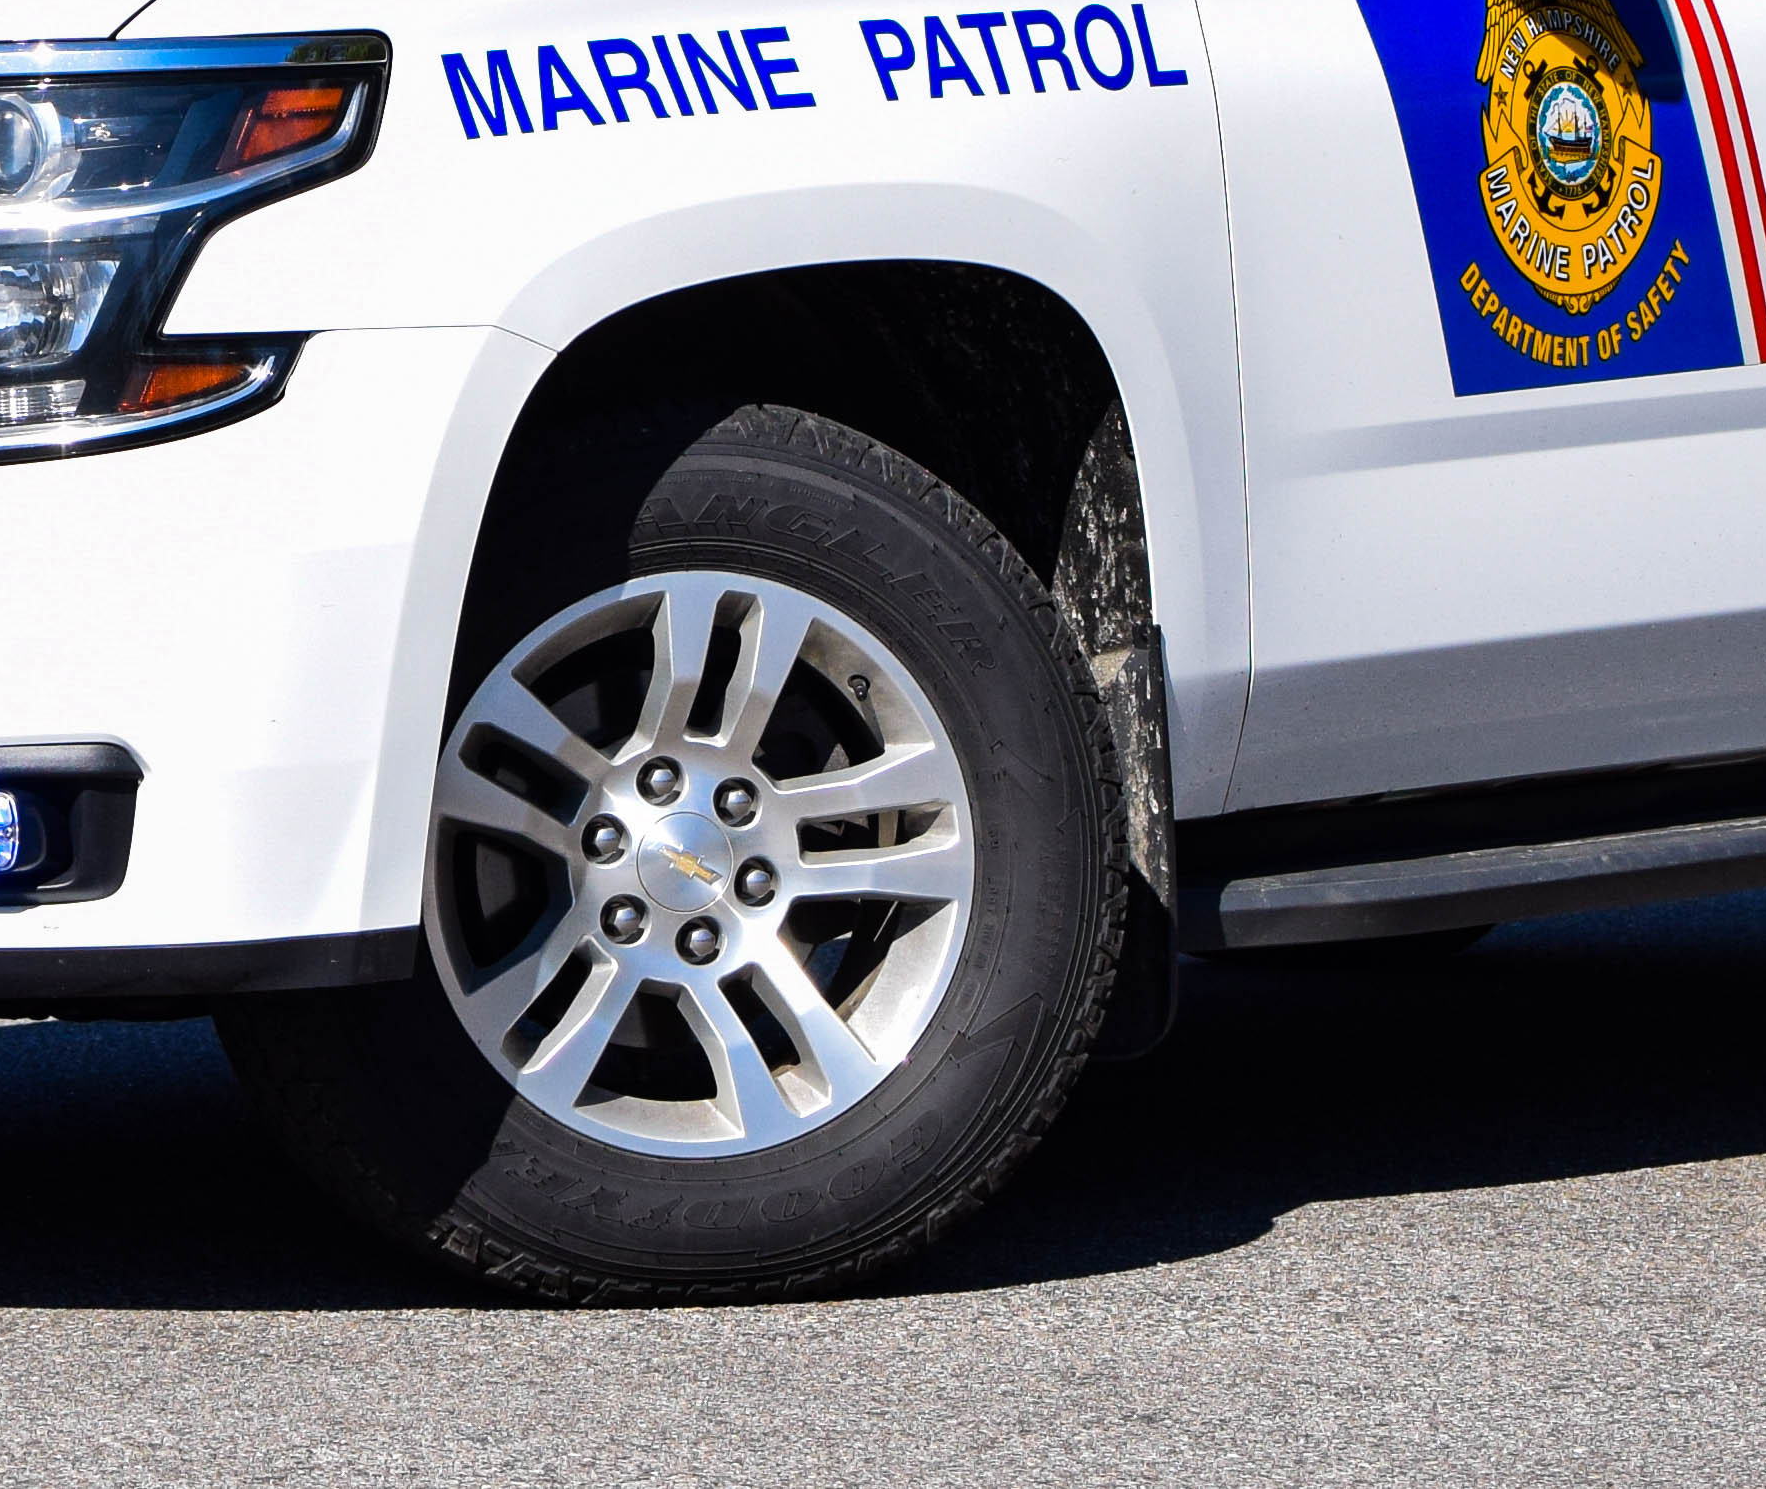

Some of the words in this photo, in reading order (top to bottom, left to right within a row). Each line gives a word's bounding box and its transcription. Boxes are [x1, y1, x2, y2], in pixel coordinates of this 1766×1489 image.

[441, 26, 817, 140] MARINE
[859, 3, 1189, 102] PATROL
[1500, 29, 1528, 80] NEW
[1524, 9, 1621, 72] HAMPSHIRE
[1486, 166, 1570, 281] MARINE
[1582, 158, 1654, 278] PATROL
[1460, 261, 1591, 367] DEPARTMENT
[1596, 322, 1623, 360] OF
[1625, 238, 1691, 342] SAFETY
[633, 493, 998, 680] ANGLER
